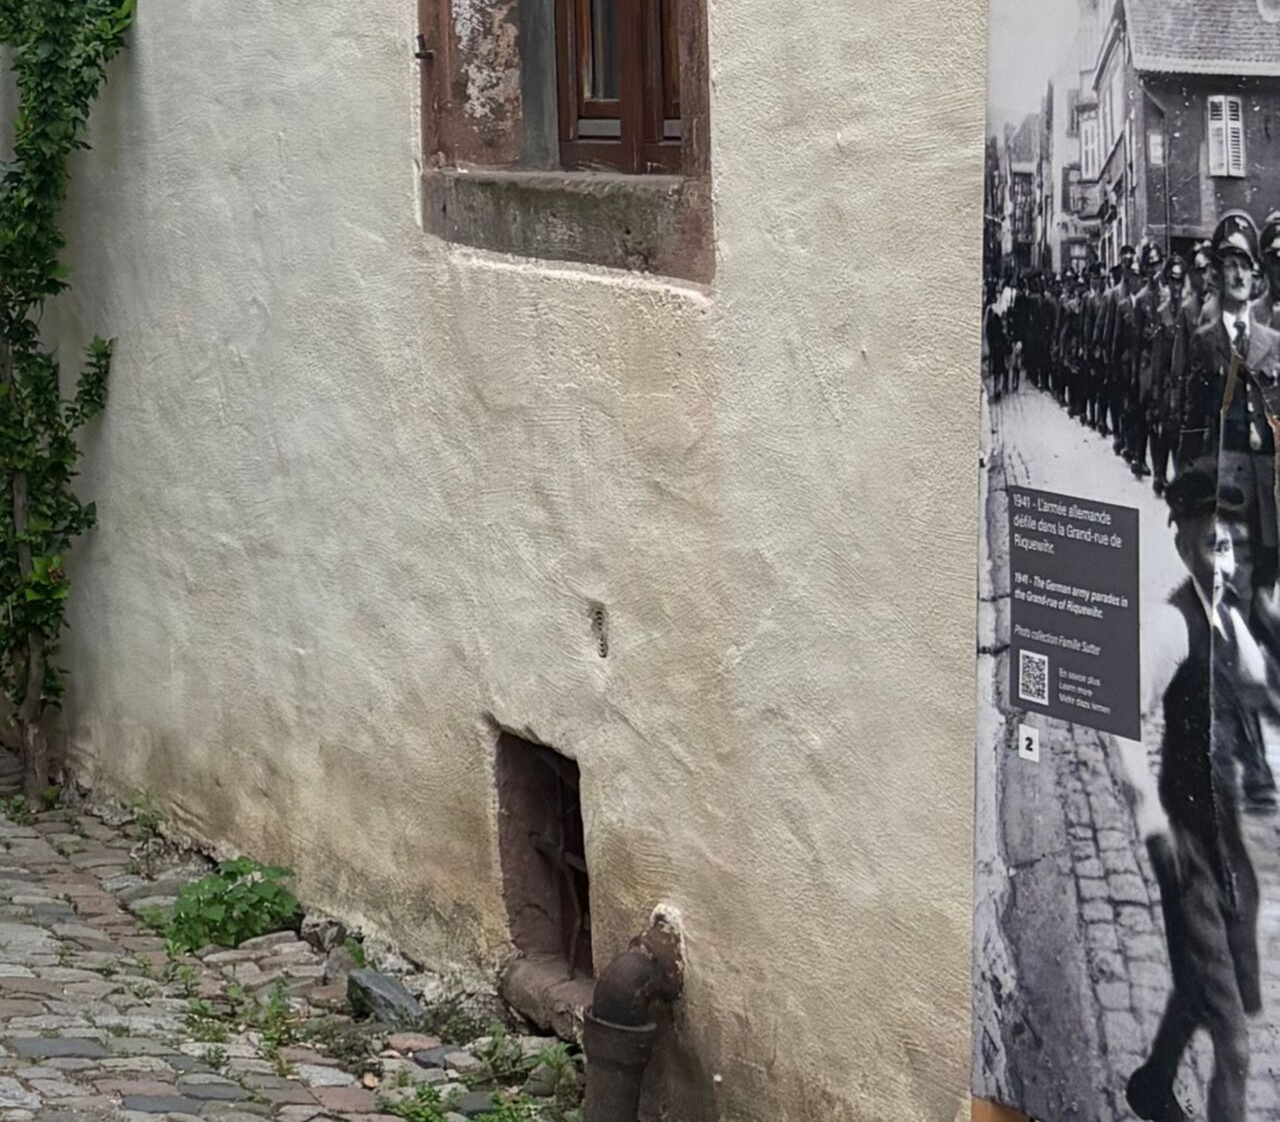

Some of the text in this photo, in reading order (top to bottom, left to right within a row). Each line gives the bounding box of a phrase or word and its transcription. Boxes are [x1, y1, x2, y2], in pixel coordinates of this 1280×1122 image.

[1013, 494, 1030, 508] 1941
[1037, 497, 1067, 515] L'armée
[1068, 504, 1111, 525] allemande
[1013, 515, 1122, 548] défile dans la Grand-rue de
[1014, 588, 1026, 600] the
[1026, 590, 1058, 608] Grand-rue
[1058, 598, 1066, 610] of
[1033, 575, 1045, 589] The
[1045, 579, 1072, 595] German
[1072, 587, 1090, 601] army
[1090, 591, 1120, 606] parades
[1120, 595, 1128, 608] in
[1014, 624, 1031, 638] Photo
[1031, 629, 1058, 645] collection
[1024, 736, 1034, 752] 2
